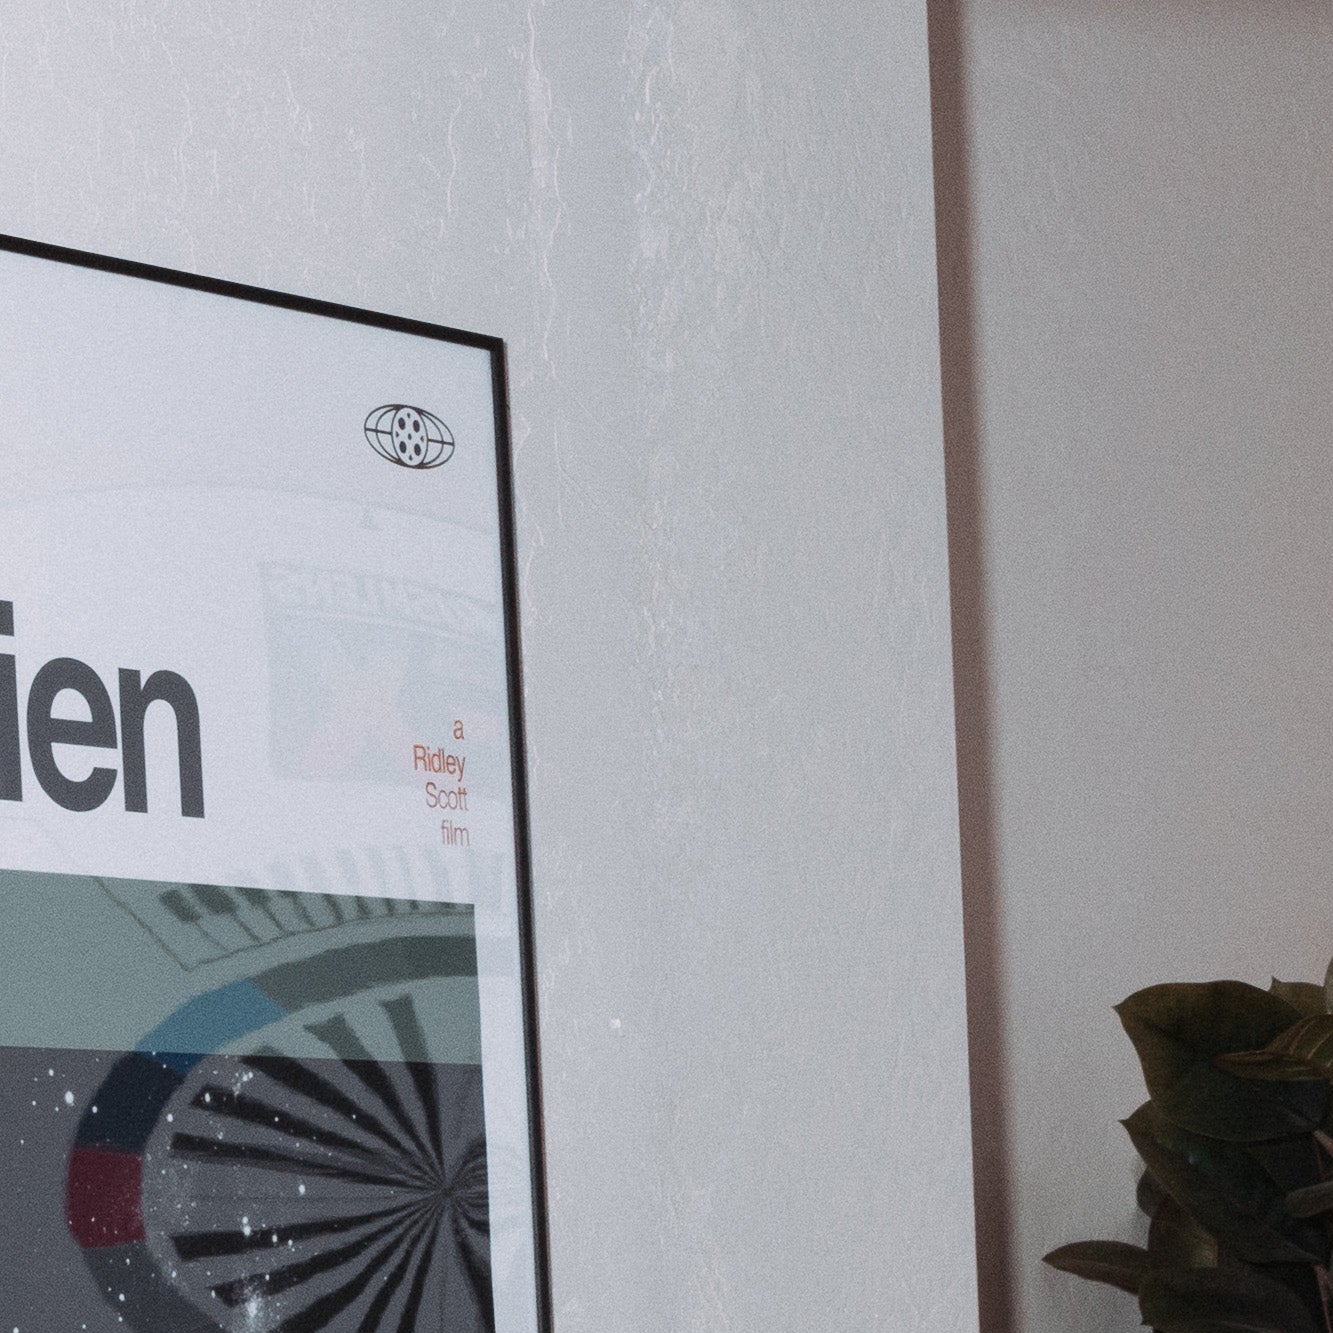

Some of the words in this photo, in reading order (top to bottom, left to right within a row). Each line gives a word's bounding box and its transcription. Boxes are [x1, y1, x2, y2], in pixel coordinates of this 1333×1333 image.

[453, 719, 464, 740] a
[413, 744, 466, 782] Ridley
[425, 781, 468, 811] Scott
[441, 819, 470, 846] film
